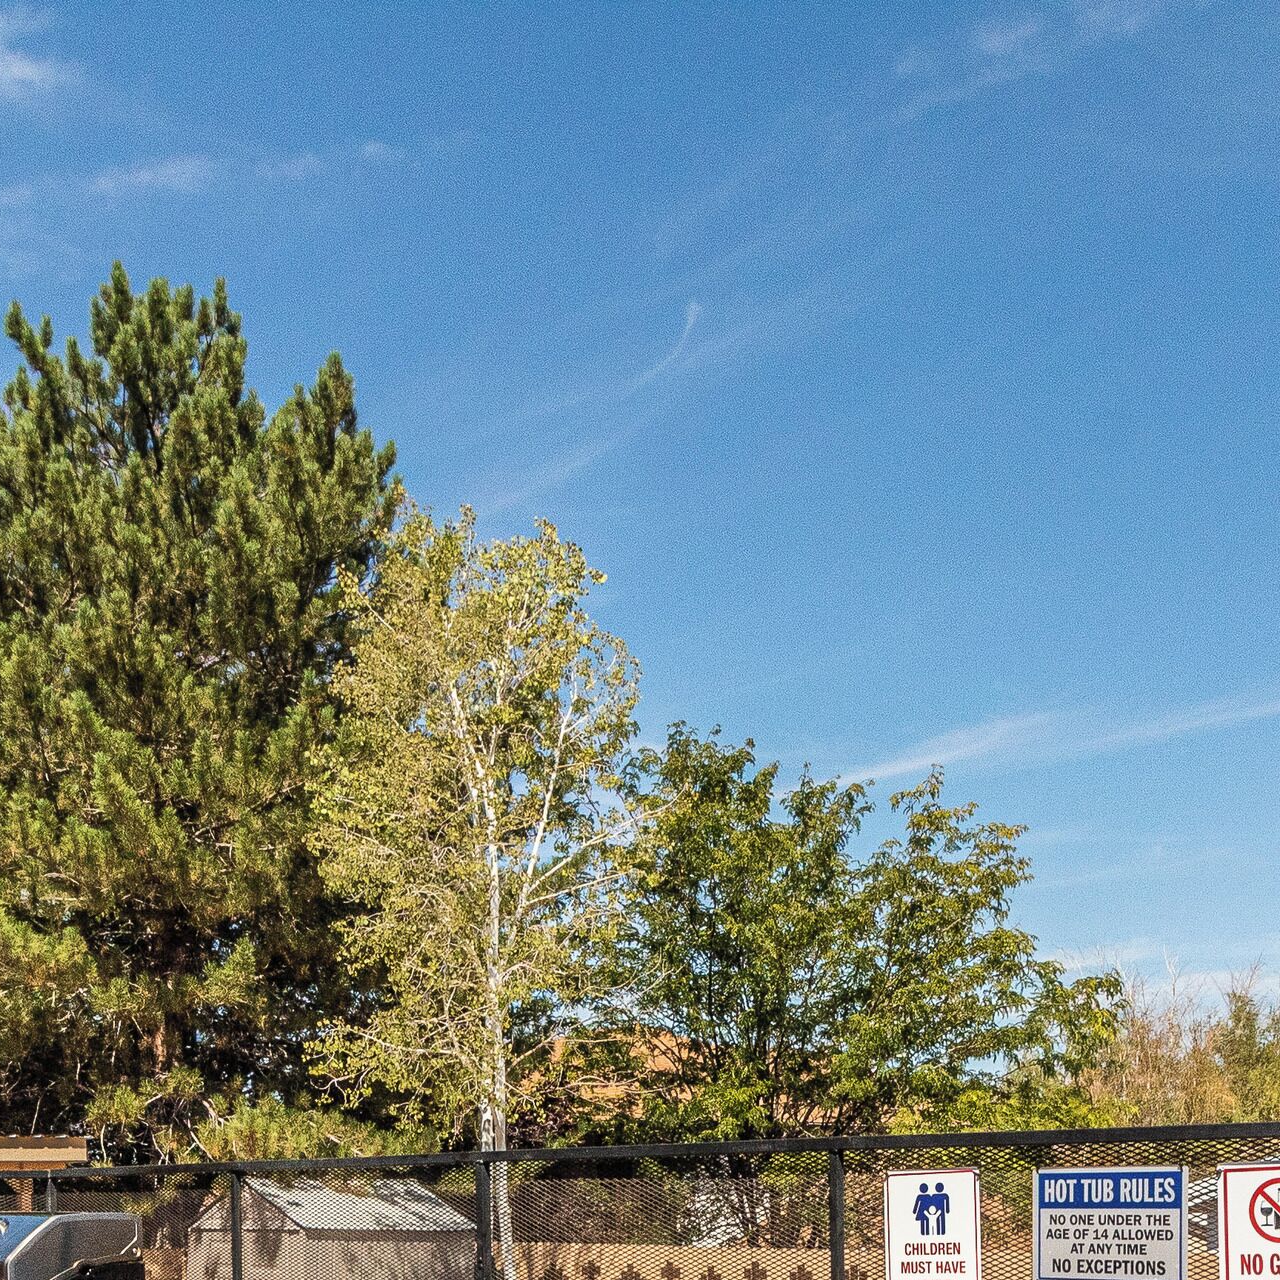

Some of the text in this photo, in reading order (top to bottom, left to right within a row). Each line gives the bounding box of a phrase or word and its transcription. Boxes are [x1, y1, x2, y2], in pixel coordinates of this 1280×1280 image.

[1044, 1177, 1176, 1203] HOT TUB RULES
[1049, 1214, 1171, 1226] NO ONE UNDER THE
[1046, 1228, 1174, 1241] AGE OF 14 ALLOWED
[904, 1242, 961, 1256] CHILDREN
[1070, 1243, 1148, 1256] AT ANY TIME
[901, 1261, 966, 1274] MUST HAVE
[1052, 1258, 1167, 1276] NO EXCEPTIONS
[1240, 1253, 1264, 1276] NO
